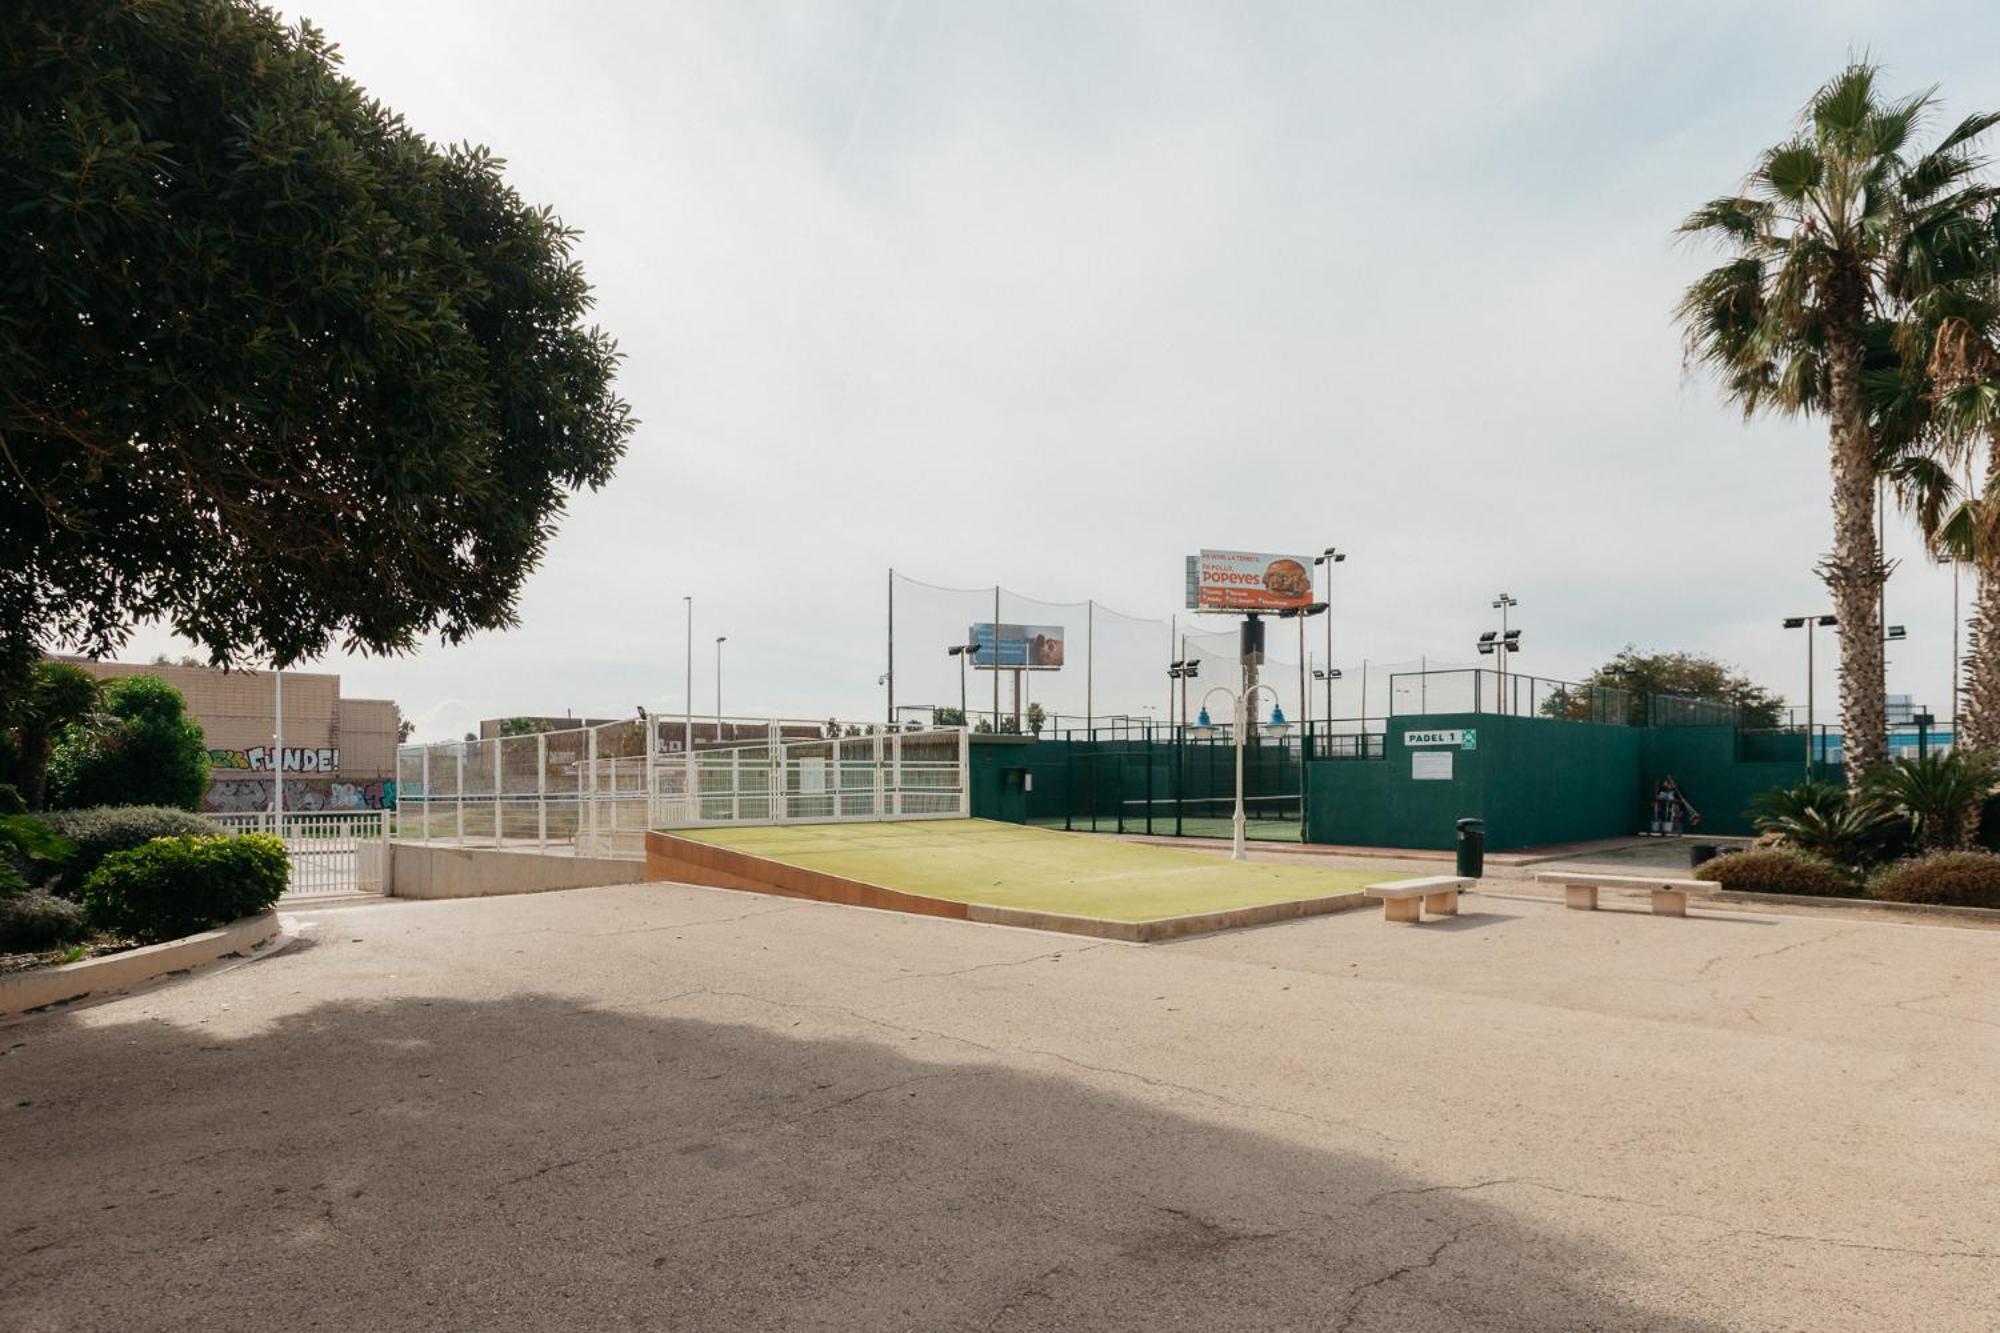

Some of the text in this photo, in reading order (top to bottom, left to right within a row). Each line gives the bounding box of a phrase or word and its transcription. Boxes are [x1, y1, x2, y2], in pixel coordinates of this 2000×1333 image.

[1409, 733, 1455, 742] PADEL 1
[247, 745, 340, 773] FUNDE!
